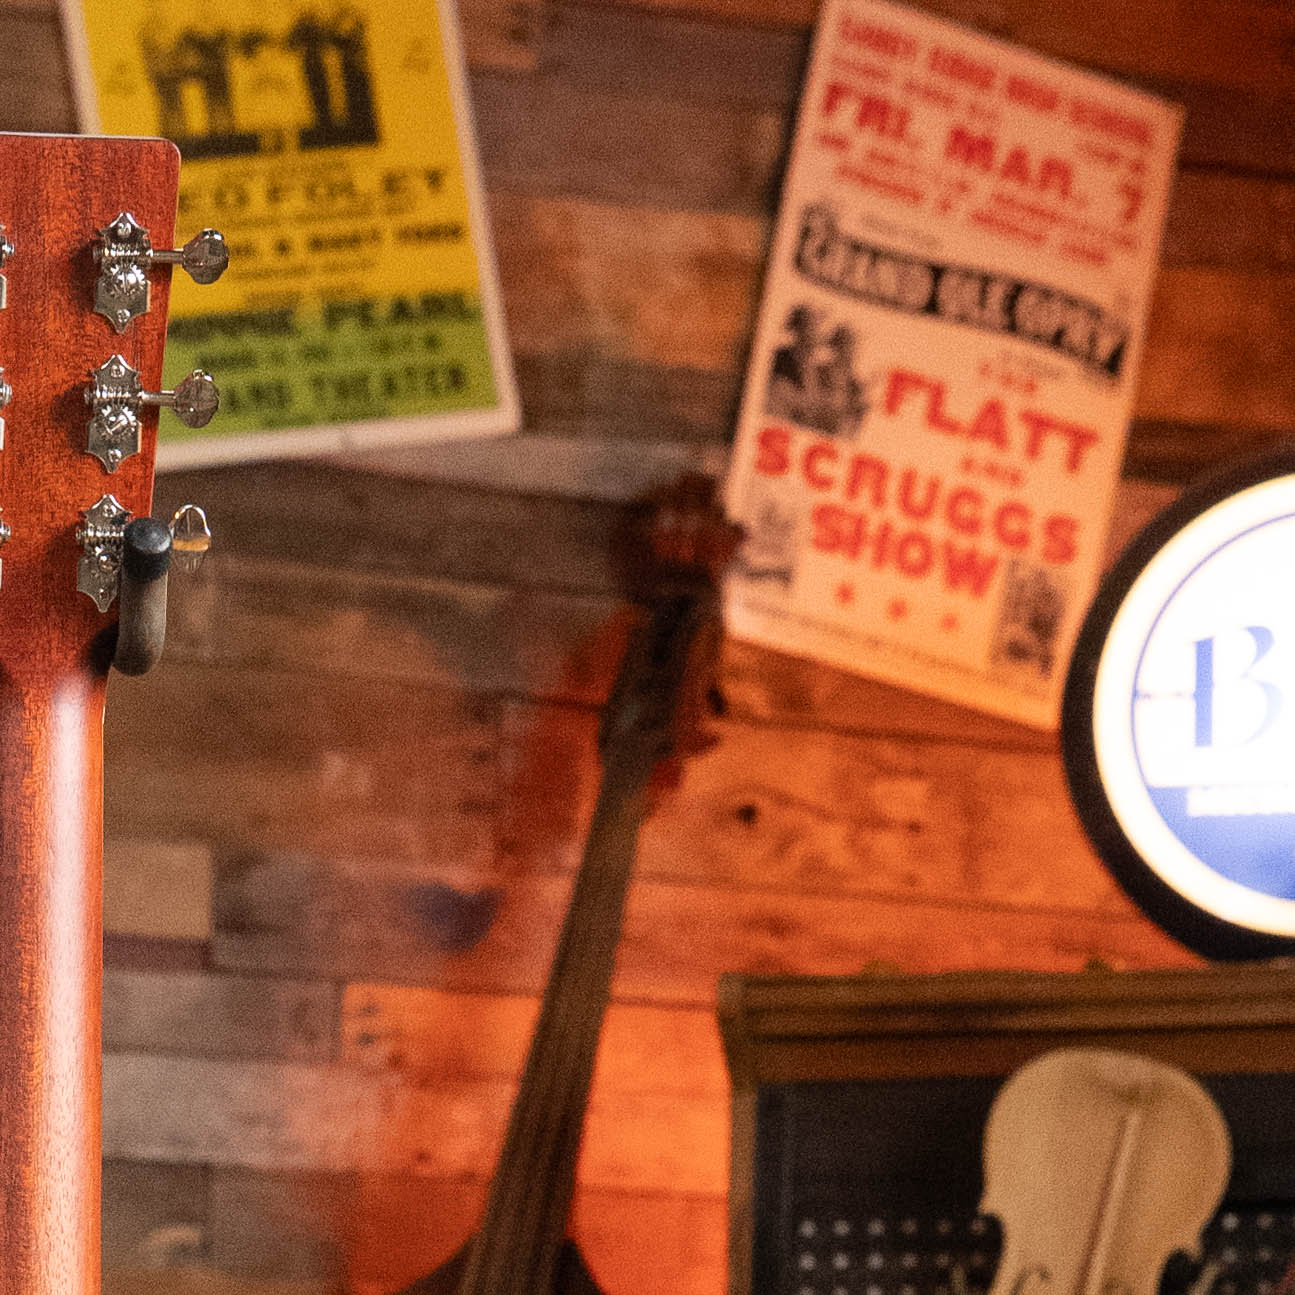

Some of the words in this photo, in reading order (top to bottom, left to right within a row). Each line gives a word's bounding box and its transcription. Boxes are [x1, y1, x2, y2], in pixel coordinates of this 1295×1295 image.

[885, 369, 1099, 474] FLATT
[755, 428, 1080, 564] SCRUGGS
[811, 505, 999, 598] SHOW
